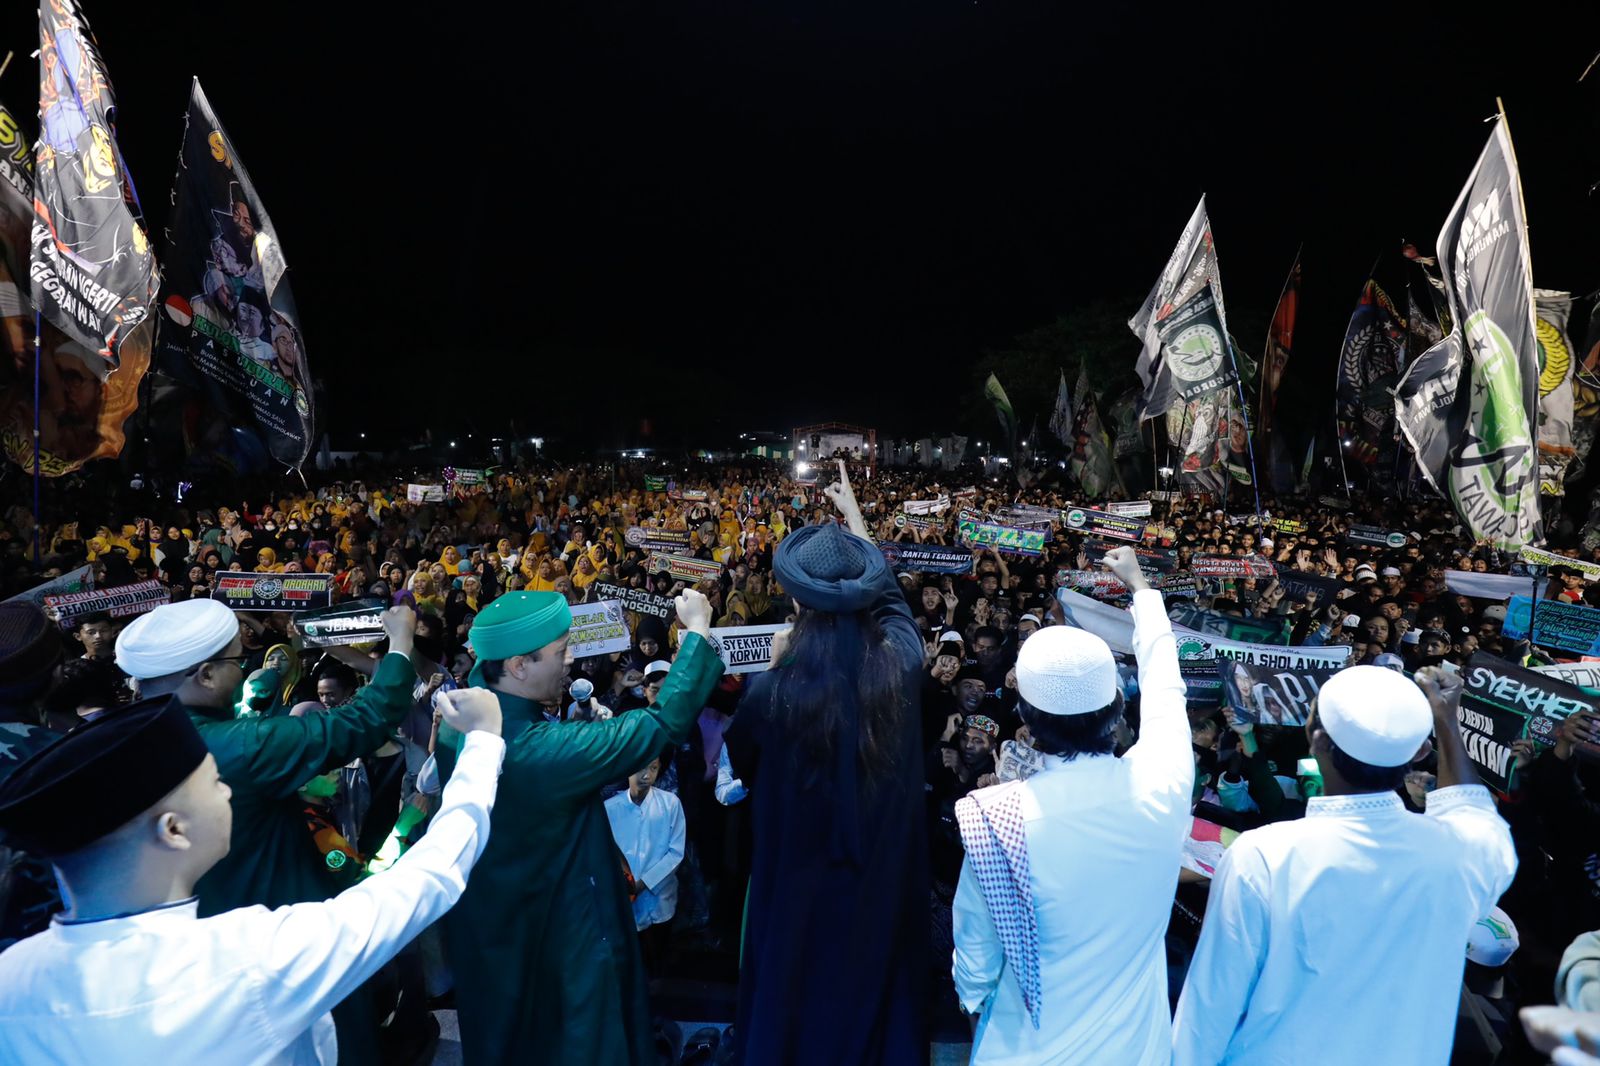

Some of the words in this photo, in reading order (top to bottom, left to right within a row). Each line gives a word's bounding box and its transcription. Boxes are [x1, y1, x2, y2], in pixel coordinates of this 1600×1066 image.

[902, 550, 930, 559] SANTRI
[932, 552, 972, 561] TERSAKITI
[47, 589, 107, 606] PASUKAN
[135, 588, 166, 602] HADIR
[594, 582, 627, 598] MAFIA
[628, 590, 676, 608] SHOLAWA
[597, 593, 668, 618] WNOSOBO
[723, 636, 774, 651] SYEKHER
[730, 647, 772, 663] KORWIL
[1215, 648, 1255, 666] MAFIA
[1259, 653, 1342, 670] SHOLAWAT
